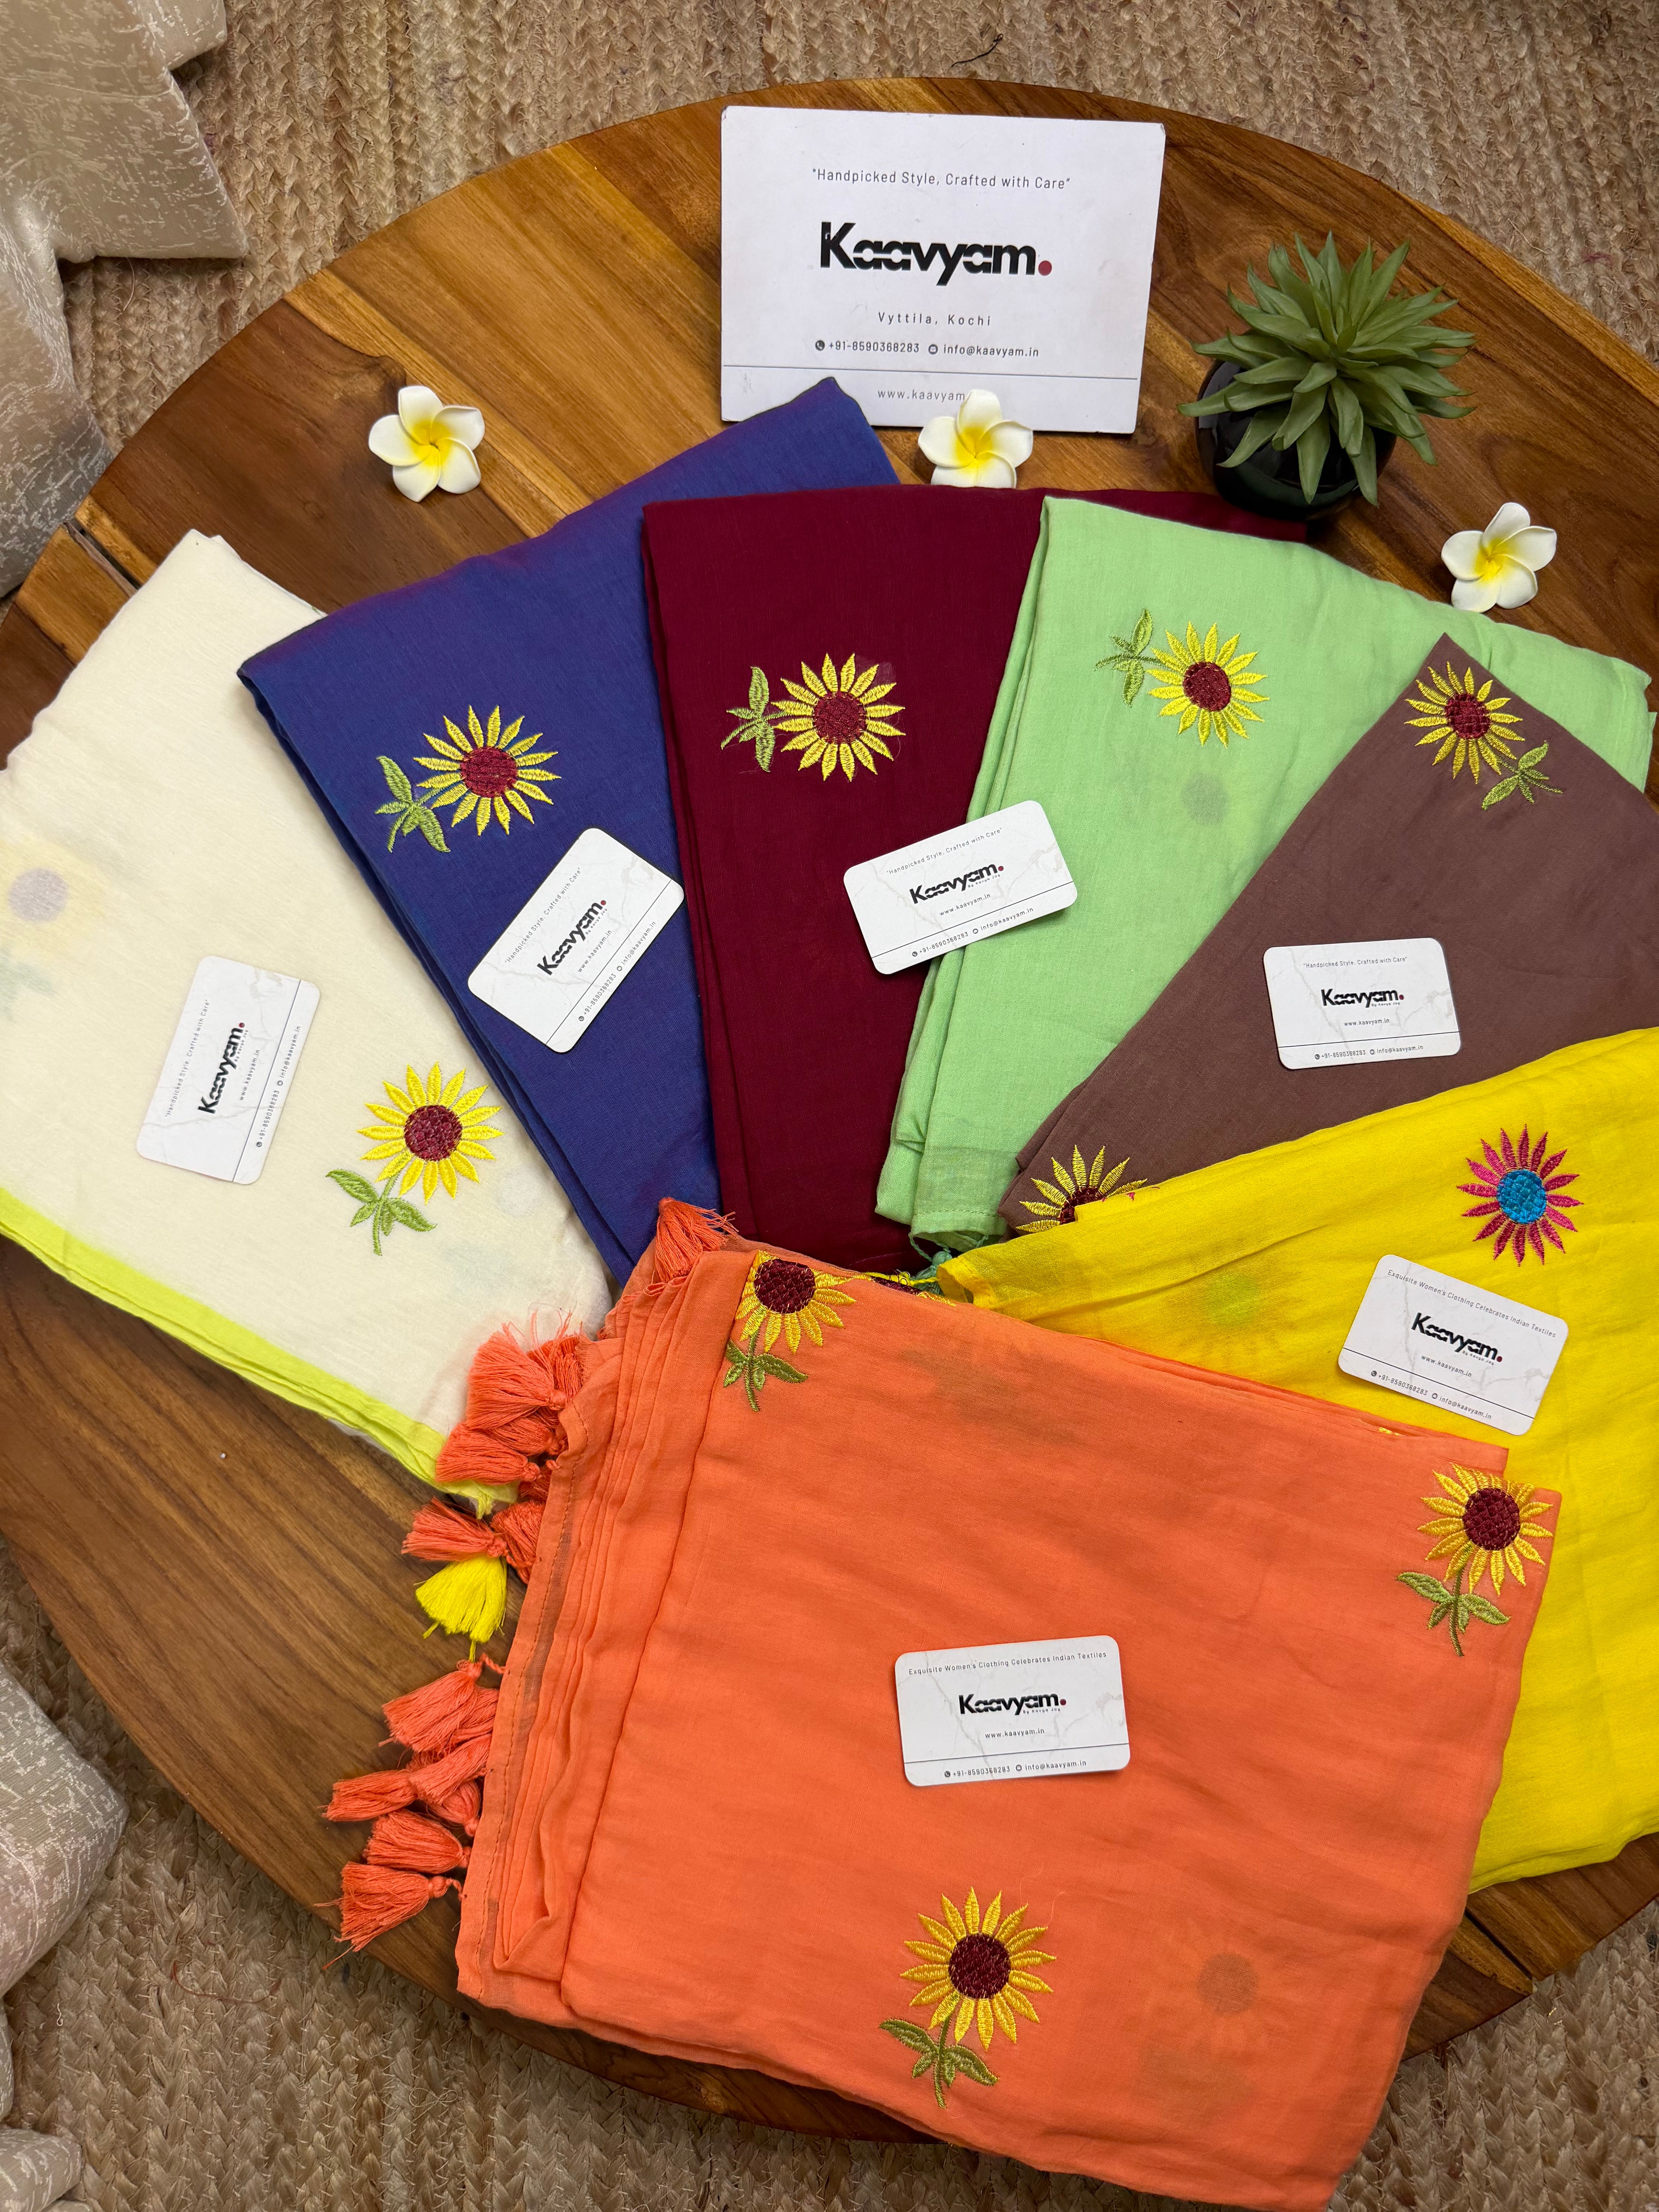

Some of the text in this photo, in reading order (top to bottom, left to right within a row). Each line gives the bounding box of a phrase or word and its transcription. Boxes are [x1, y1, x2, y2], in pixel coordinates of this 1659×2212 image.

[902, 172, 939, 186] Style,
[946, 173, 996, 186] Crafted
[1002, 176, 1029, 187] with
[879, 312, 990, 326] Vyttila, Kochi
[829, 341, 1038, 358] +91-8590368283 info@kaavyam.in
[878, 389, 965, 402] www.kaavyam
[945, 840, 969, 853] Crafted
[970, 835, 984, 843] with
[543, 894, 562, 915] Crafted
[560, 883, 571, 895] with
[939, 893, 991, 916] www.kaavyam.in
[980, 908, 1034, 931] info@kaavyam.in
[577, 930, 612, 972] www.kaavyam.in
[584, 921, 656, 1015] +91-8590368283 info@kaavyam.in
[1343, 1018, 1389, 1026] www.kaavyam.in
[186, 1032, 199, 1057] Crafted
[196, 1018, 204, 1031] with
[279, 1025, 301, 1078] info@kaavyam.in
[1376, 1044, 1423, 1054] info@kaavyam.in
[239, 1049, 260, 1101] www.kaavyam.in
[1387, 1269, 1417, 1285] Exquisite
[1447, 1292, 1474, 1307] Clothing
[1475, 1302, 1509, 1320] Celebrates
[1510, 1316, 1529, 1328] Indian
[1531, 1323, 1556, 1338] Textiles
[1421, 1355, 1472, 1377] www.kaavyam.in
[1378, 1374, 1491, 1419] +91-8590368283 info@kaavyam.in
[908, 1666, 942, 1675] Exquisite
[978, 1660, 1009, 1668] Clothing
[1011, 1657, 1050, 1665] Celebrates
[984, 1728, 1044, 1738] www.kaavyam.in
[953, 1759, 1086, 1777] +91-8590368283 info@kaavyam.in
